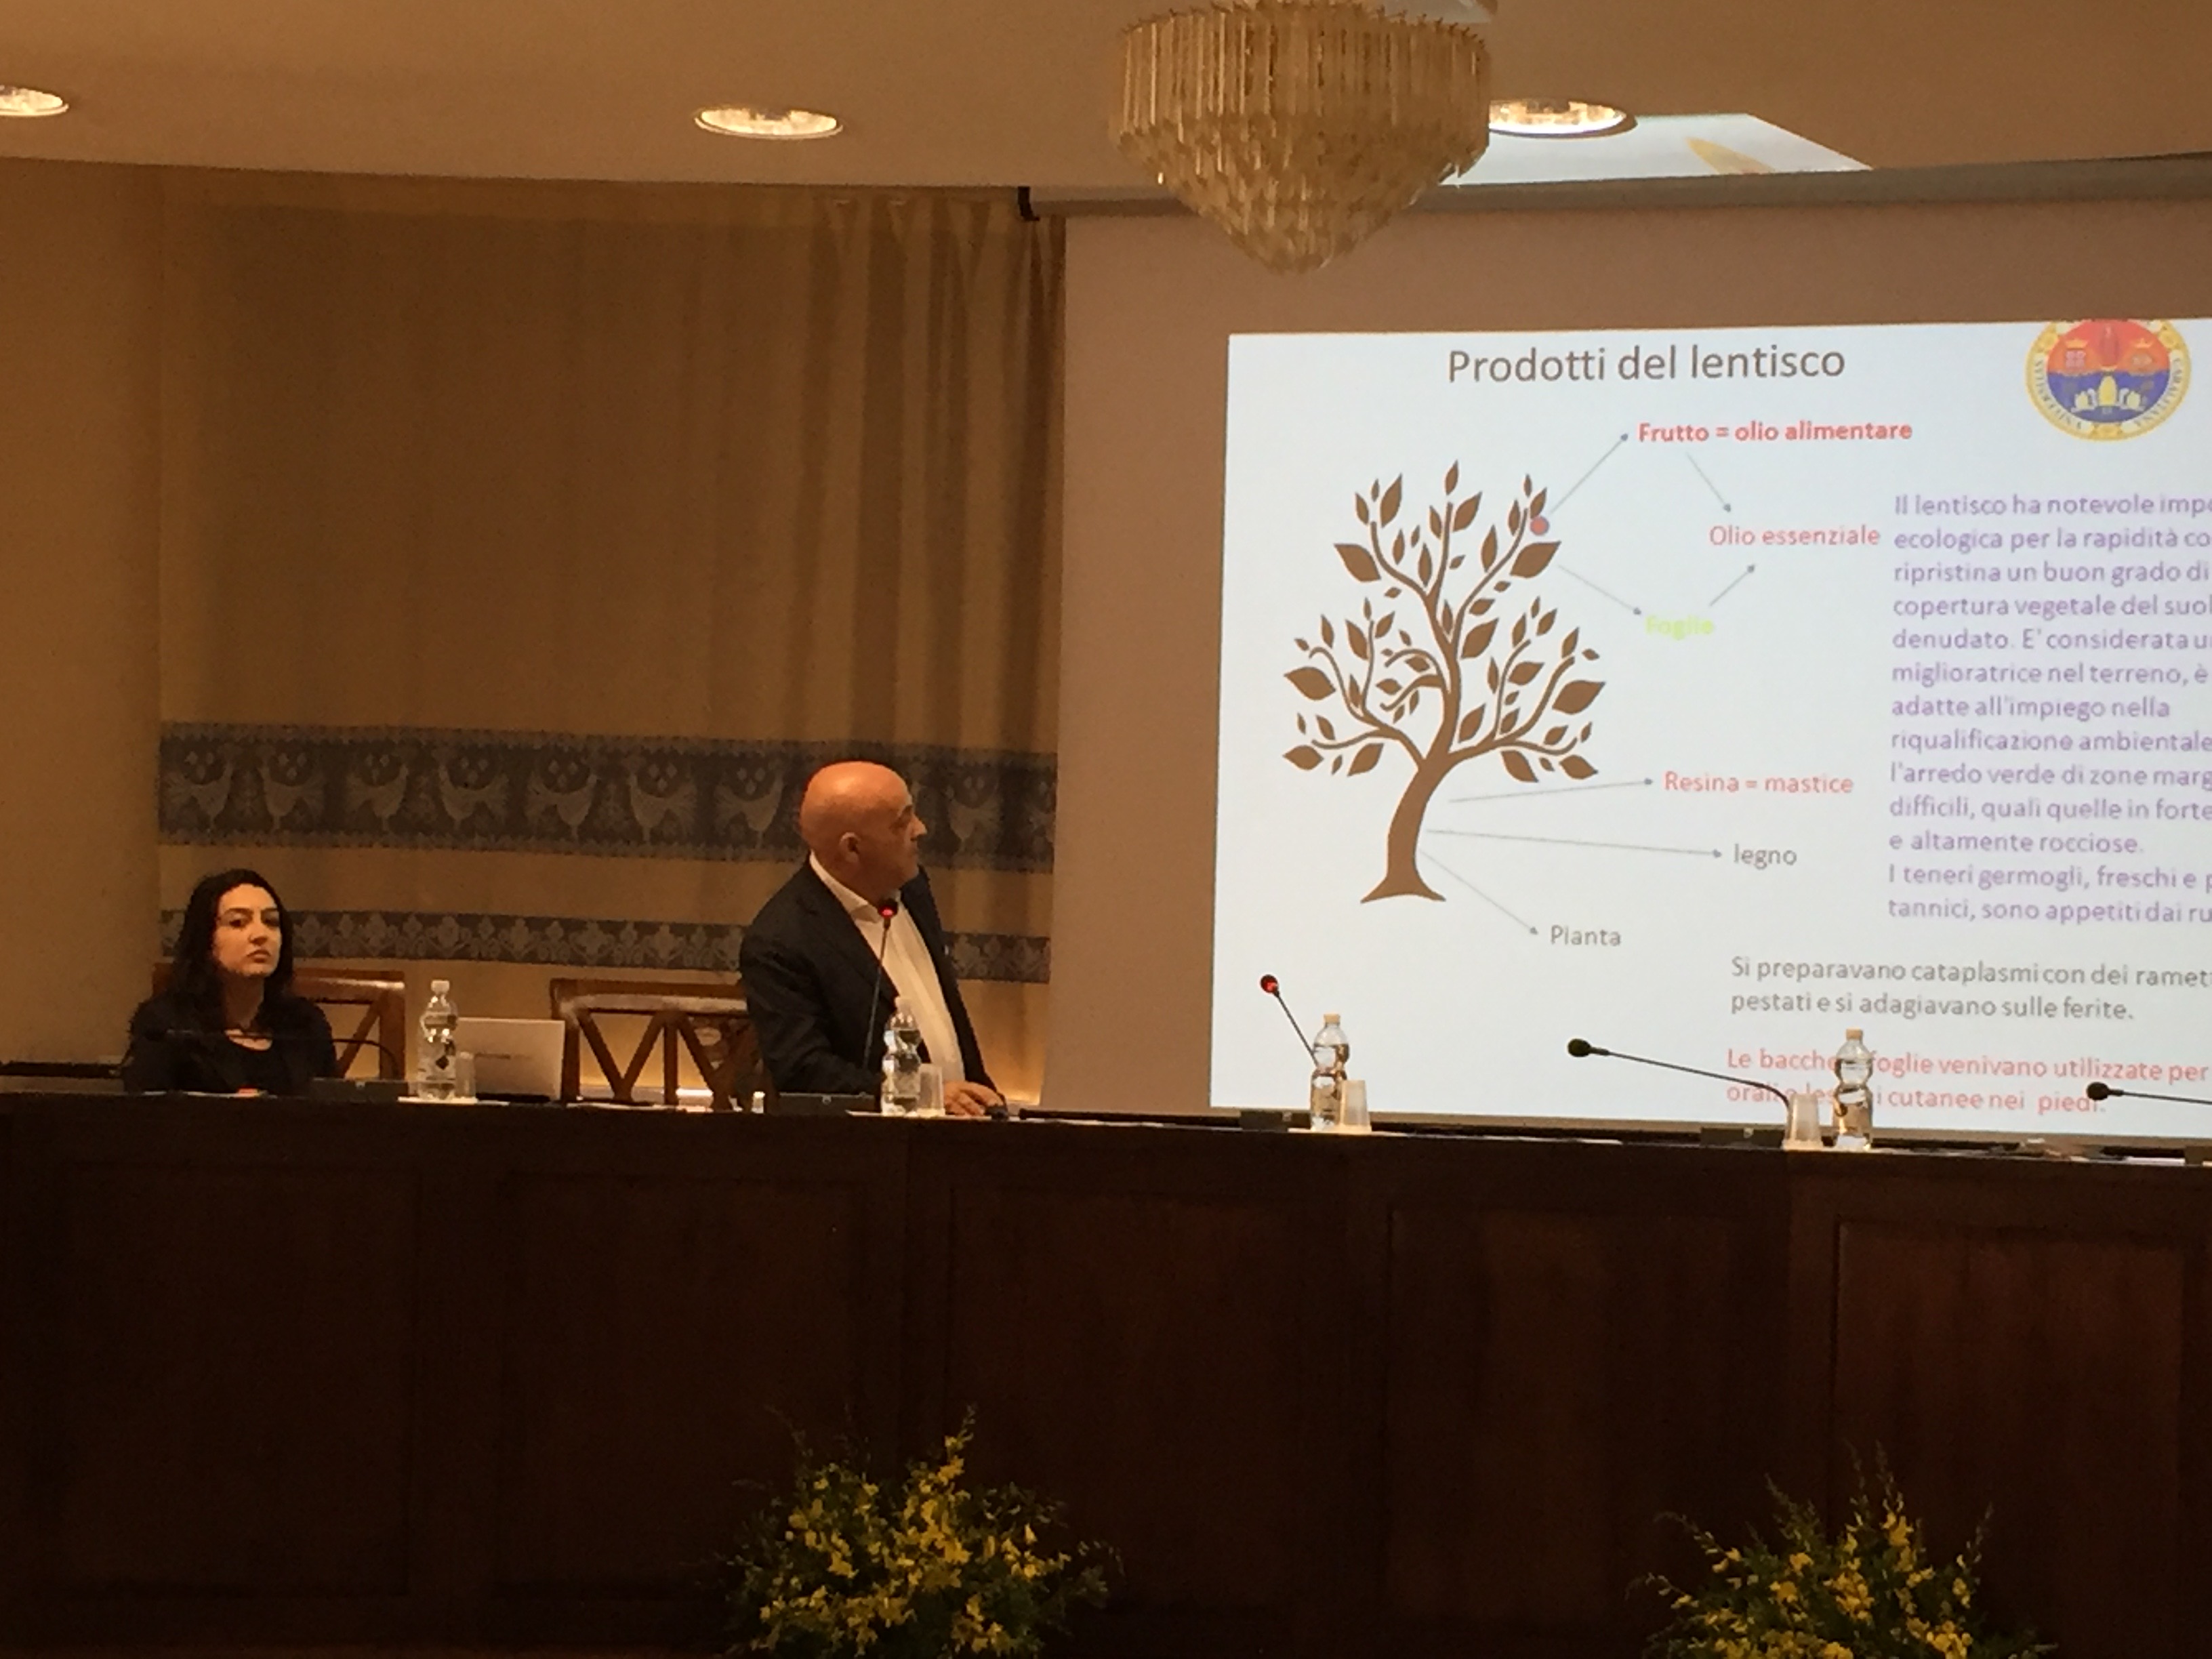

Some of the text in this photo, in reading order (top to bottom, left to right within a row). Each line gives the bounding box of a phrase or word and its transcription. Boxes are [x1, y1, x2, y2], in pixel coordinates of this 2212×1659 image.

[1449, 344, 1846, 383] Prodotti del lentisco
[1637, 420, 1912, 442] Frutto = olio alimentare
[1895, 495, 1908, 515] Il
[1914, 495, 2007, 516] lentisco
[2012, 494, 2041, 514] ha
[2047, 493, 2155, 514] notevole
[1708, 525, 1881, 546] Olio essenziale
[1893, 529, 2003, 554] ecologica
[2011, 531, 2050, 552] per
[2057, 527, 2078, 548] la
[2083, 527, 2179, 552] rapidità
[1893, 560, 2210, 587] ripristina un buon grado di
[1893, 596, 2010, 619] copertura
[2015, 594, 2116, 621] vegetale
[2121, 595, 2159, 615] del
[1645, 615, 1715, 638] Foglie
[2046, 630, 2189, 650] considerata
[1891, 662, 2209, 688] miglioratrice nel terreno, è
[1891, 695, 2171, 722] adatte all'impiego nella
[1891, 729, 2212, 754] riqualificazione ambientale
[1664, 771, 1854, 794] Resina = mastice
[1890, 762, 1982, 784] l'arredo
[1988, 763, 2055, 785] verde
[2061, 765, 2084, 785] di
[2090, 769, 2148, 785] zone
[1889, 795, 2212, 822] difficili, quali quelle in forte
[1889, 834, 1903, 850] e
[1910, 830, 2034, 852] altamente
[1734, 843, 1797, 869] legno
[1888, 864, 1895, 883] I
[1903, 864, 1973, 884] teneri
[1978, 865, 2090, 891] germogli,
[2097, 865, 2177, 888] freschi
[2182, 872, 2196, 888] e
[1888, 899, 2212, 925] tannici, sono appetiti dai ru
[1551, 926, 1621, 947] Pianta
[1732, 956, 1750, 977] Si
[1757, 960, 1906, 983] preparavano
[1911, 960, 2041, 986] cataplasmi
[2043, 968, 2085, 985] con
[2091, 964, 2128, 985] dei
[1731, 992, 2133, 1020] pestati e si adagiavano sulle ferite.
[1727, 1049, 1752, 1069] Le
[1872, 1051, 1932, 1077] foglie
[1938, 1055, 2048, 1078] venivano
[2054, 1057, 2163, 1081] utilizzate
[2169, 1062, 2207, 1085] per
[1889, 1087, 1982, 1110] cutanee
[1988, 1091, 2024, 1111] nei
